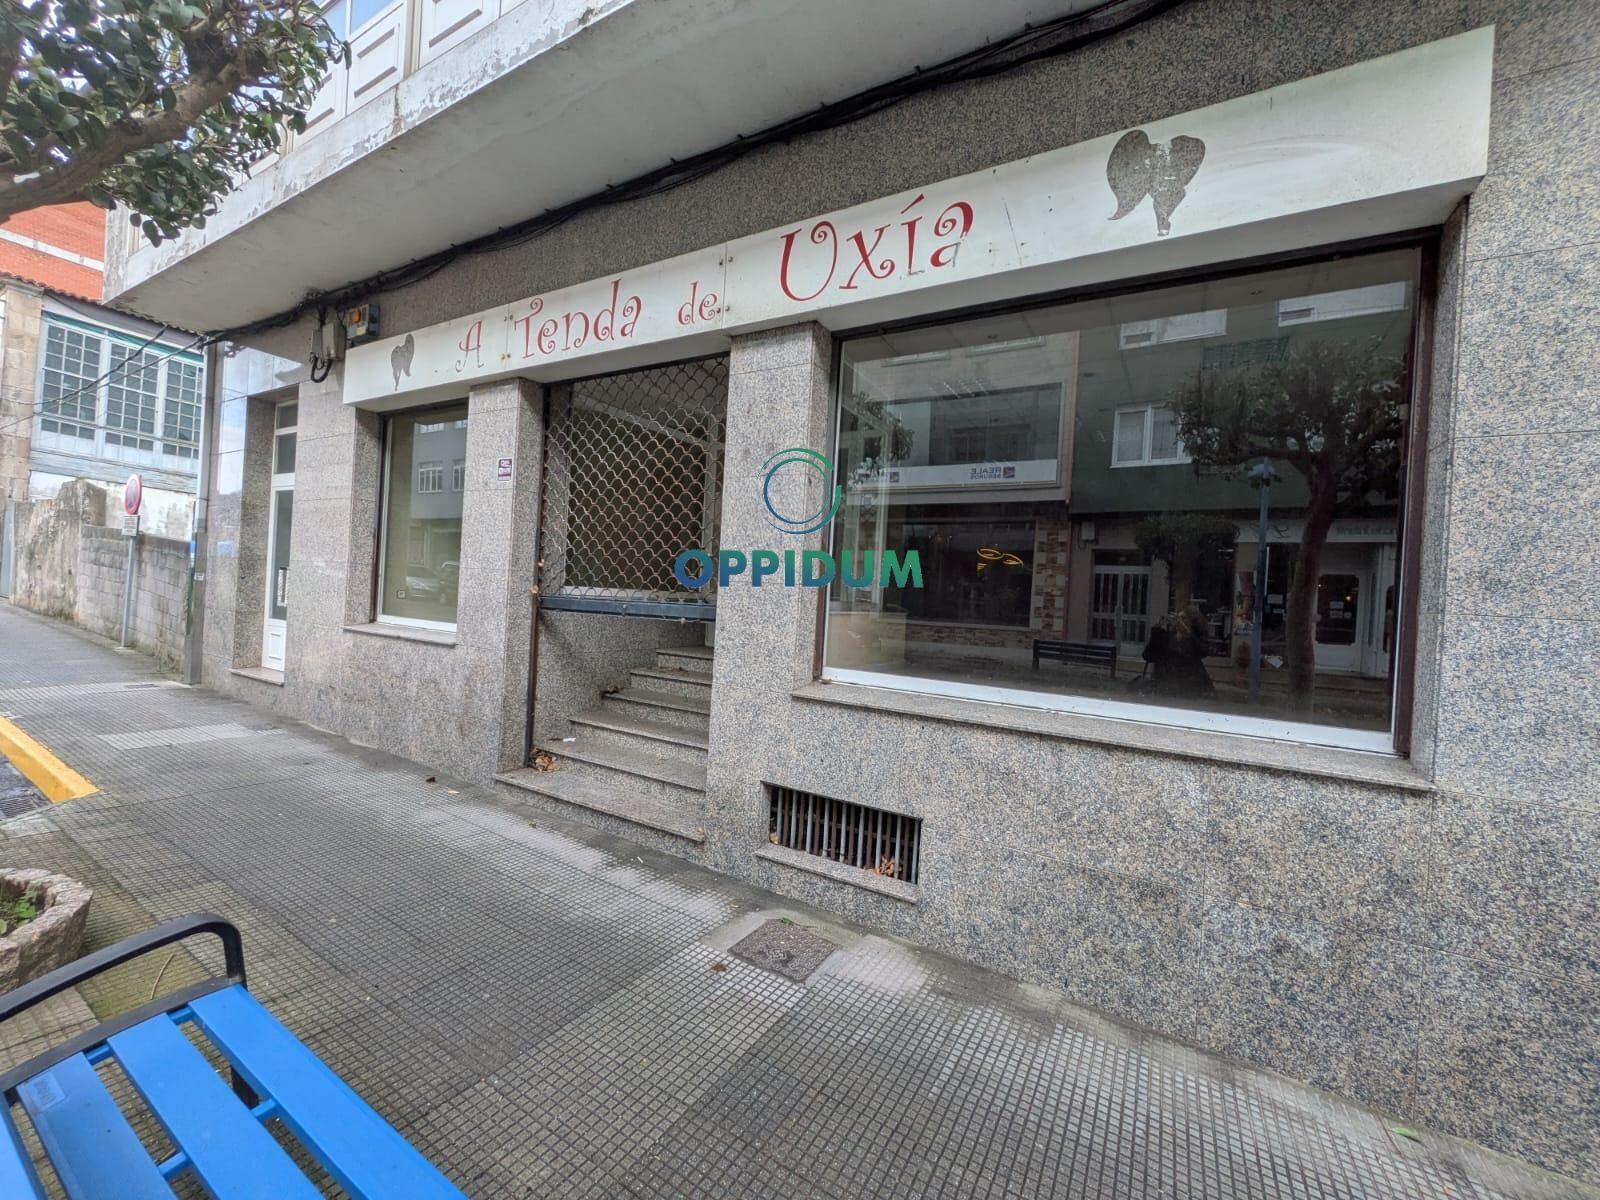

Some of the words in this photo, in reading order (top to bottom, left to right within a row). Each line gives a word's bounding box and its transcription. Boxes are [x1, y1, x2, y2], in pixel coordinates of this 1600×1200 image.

[455, 320, 485, 373] A
[514, 278, 642, 360] Tenda
[677, 280, 718, 326] de
